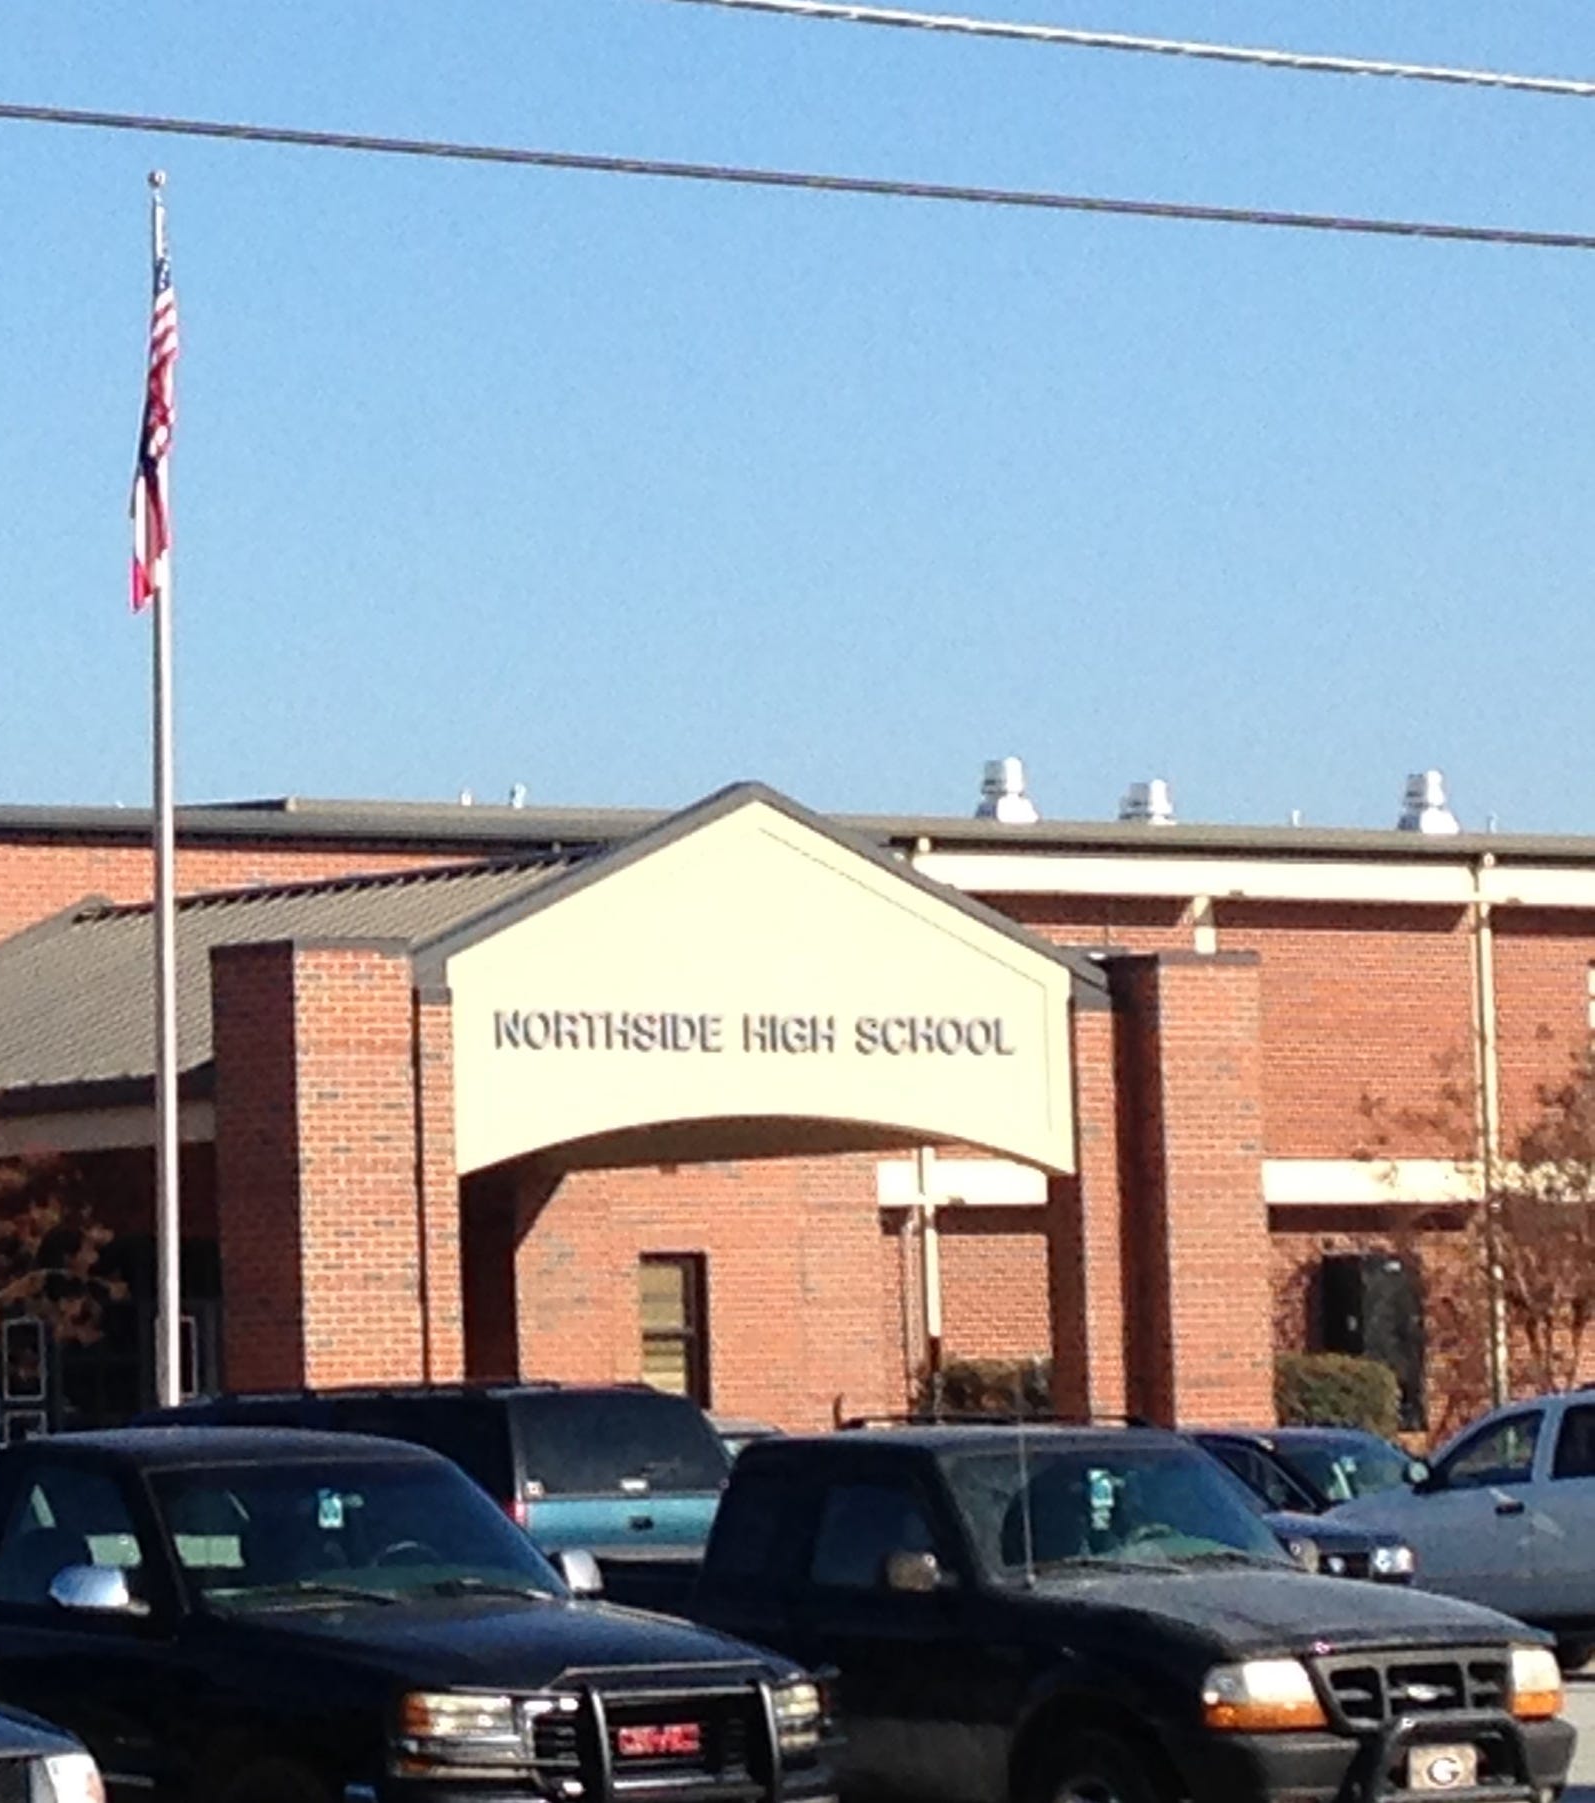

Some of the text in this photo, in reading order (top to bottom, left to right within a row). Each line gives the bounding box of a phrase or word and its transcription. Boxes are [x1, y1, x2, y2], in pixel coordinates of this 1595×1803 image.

[493, 1009, 1016, 1056] NORTHSIDE HIGH SCHOOL
[1426, 1756, 1460, 1786] G
